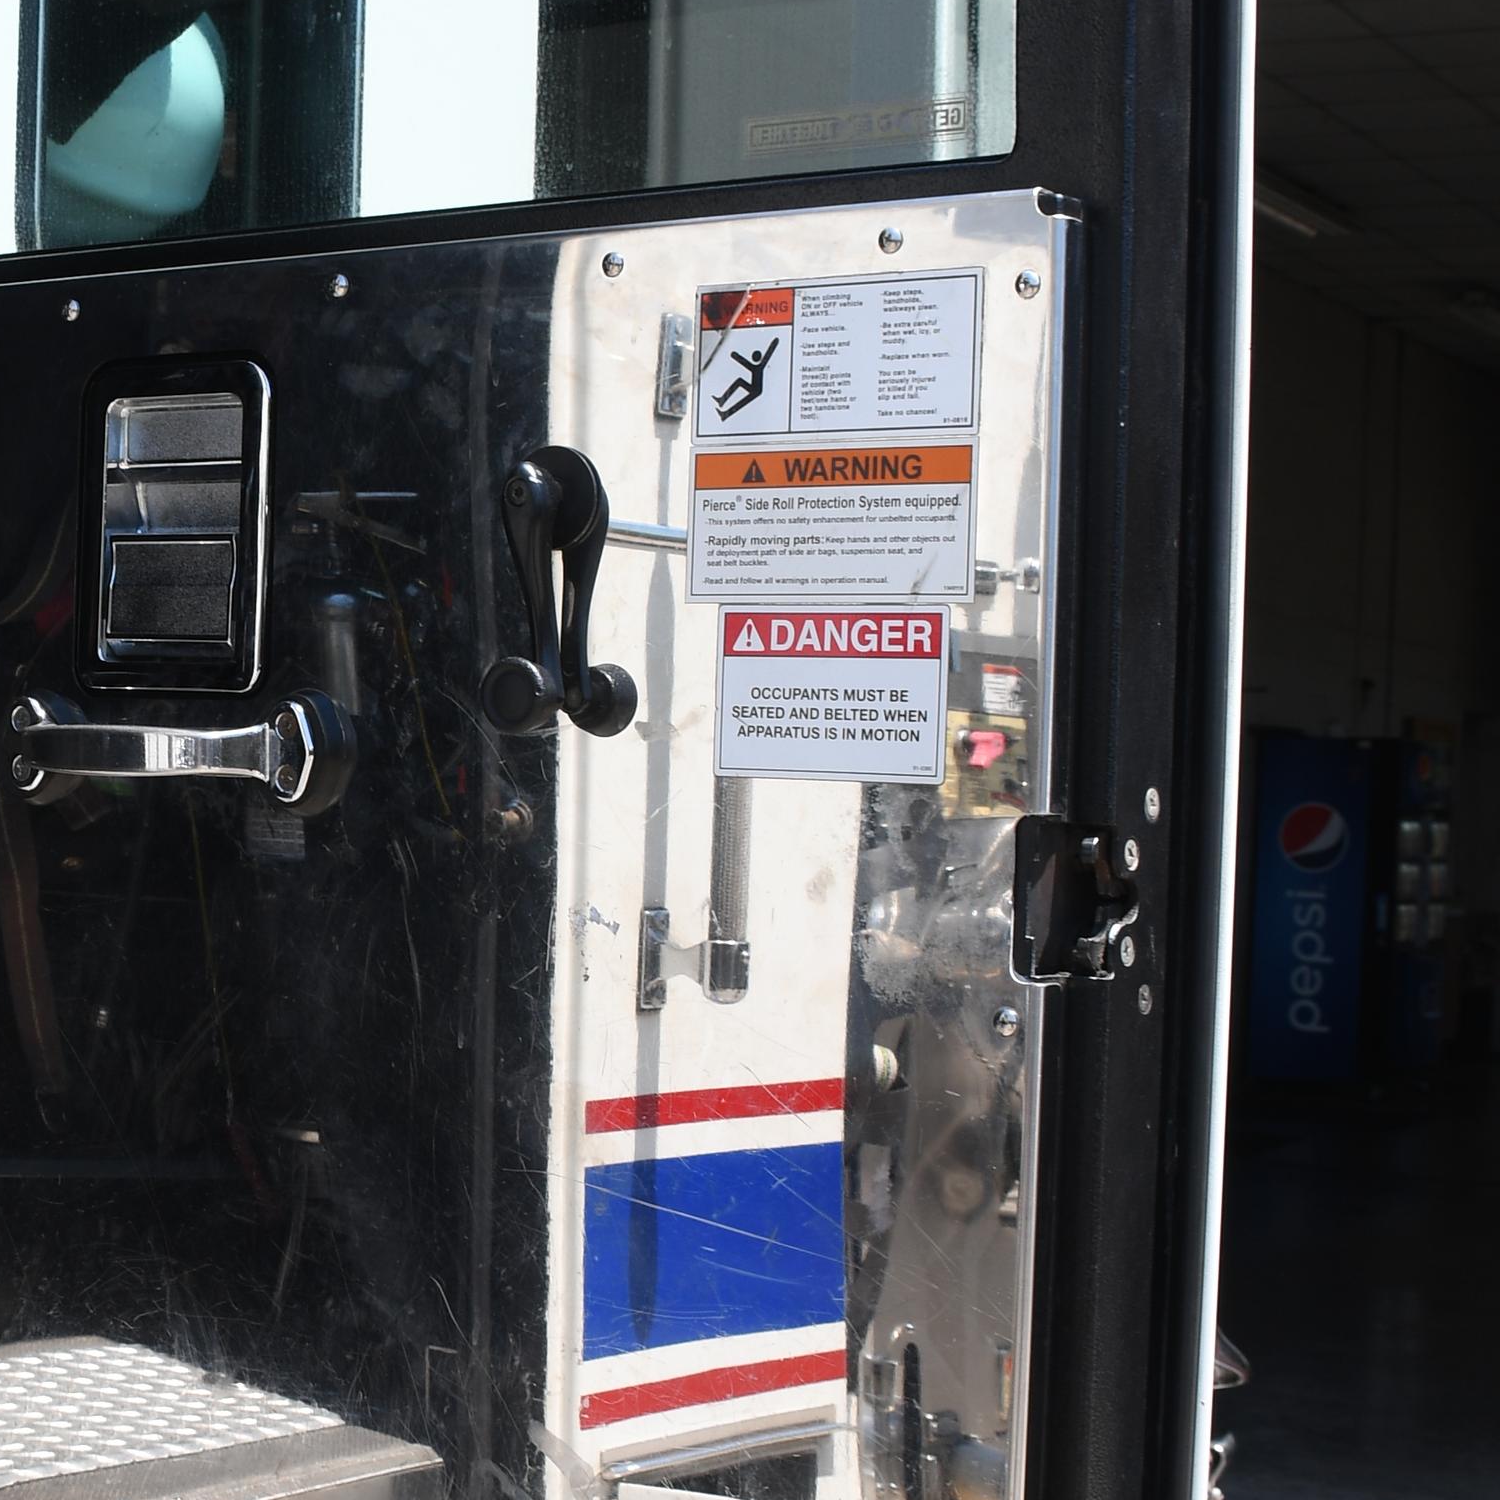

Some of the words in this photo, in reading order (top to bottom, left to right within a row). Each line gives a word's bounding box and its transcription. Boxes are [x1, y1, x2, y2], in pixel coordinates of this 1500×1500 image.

[878, 377, 909, 385] seriously
[912, 375, 937, 384] injured
[887, 384, 906, 392] killed
[784, 454, 922, 482] WARNING
[745, 498, 769, 511] Side
[772, 497, 794, 510] Roll
[798, 496, 855, 509] Protection
[859, 495, 901, 511] System
[905, 494, 962, 509] equipped.
[725, 518, 751, 526] system
[788, 517, 810, 525] safety
[812, 515, 864, 523] enhancement
[879, 514, 913, 522] unbelted
[750, 535, 790, 547] moving
[793, 535, 825, 547] parts:
[825, 536, 845, 544] Keep
[911, 535, 940, 544] objects
[716, 549, 758, 557] deployment
[760, 549, 777, 557] path
[841, 547, 886, 556] suspension
[724, 559, 738, 567] belt
[775, 577, 809, 585] warnings
[820, 577, 857, 585] operation
[770, 619, 933, 652] DANGER
[750, 687, 839, 701] OCCUPANTS
[843, 688, 885, 703] MUST
[889, 689, 909, 703] BE
[731, 705, 785, 719] SEATED
[789, 707, 820, 720] AND
[824, 707, 879, 722] BELTED
[883, 709, 928, 723] WHEN
[737, 725, 820, 740] APPARATUS
[824, 726, 838, 740] IS
[842, 727, 856, 741] IN
[861, 728, 921, 742] MOTION
[1286, 887, 1334, 1032] pepsi
